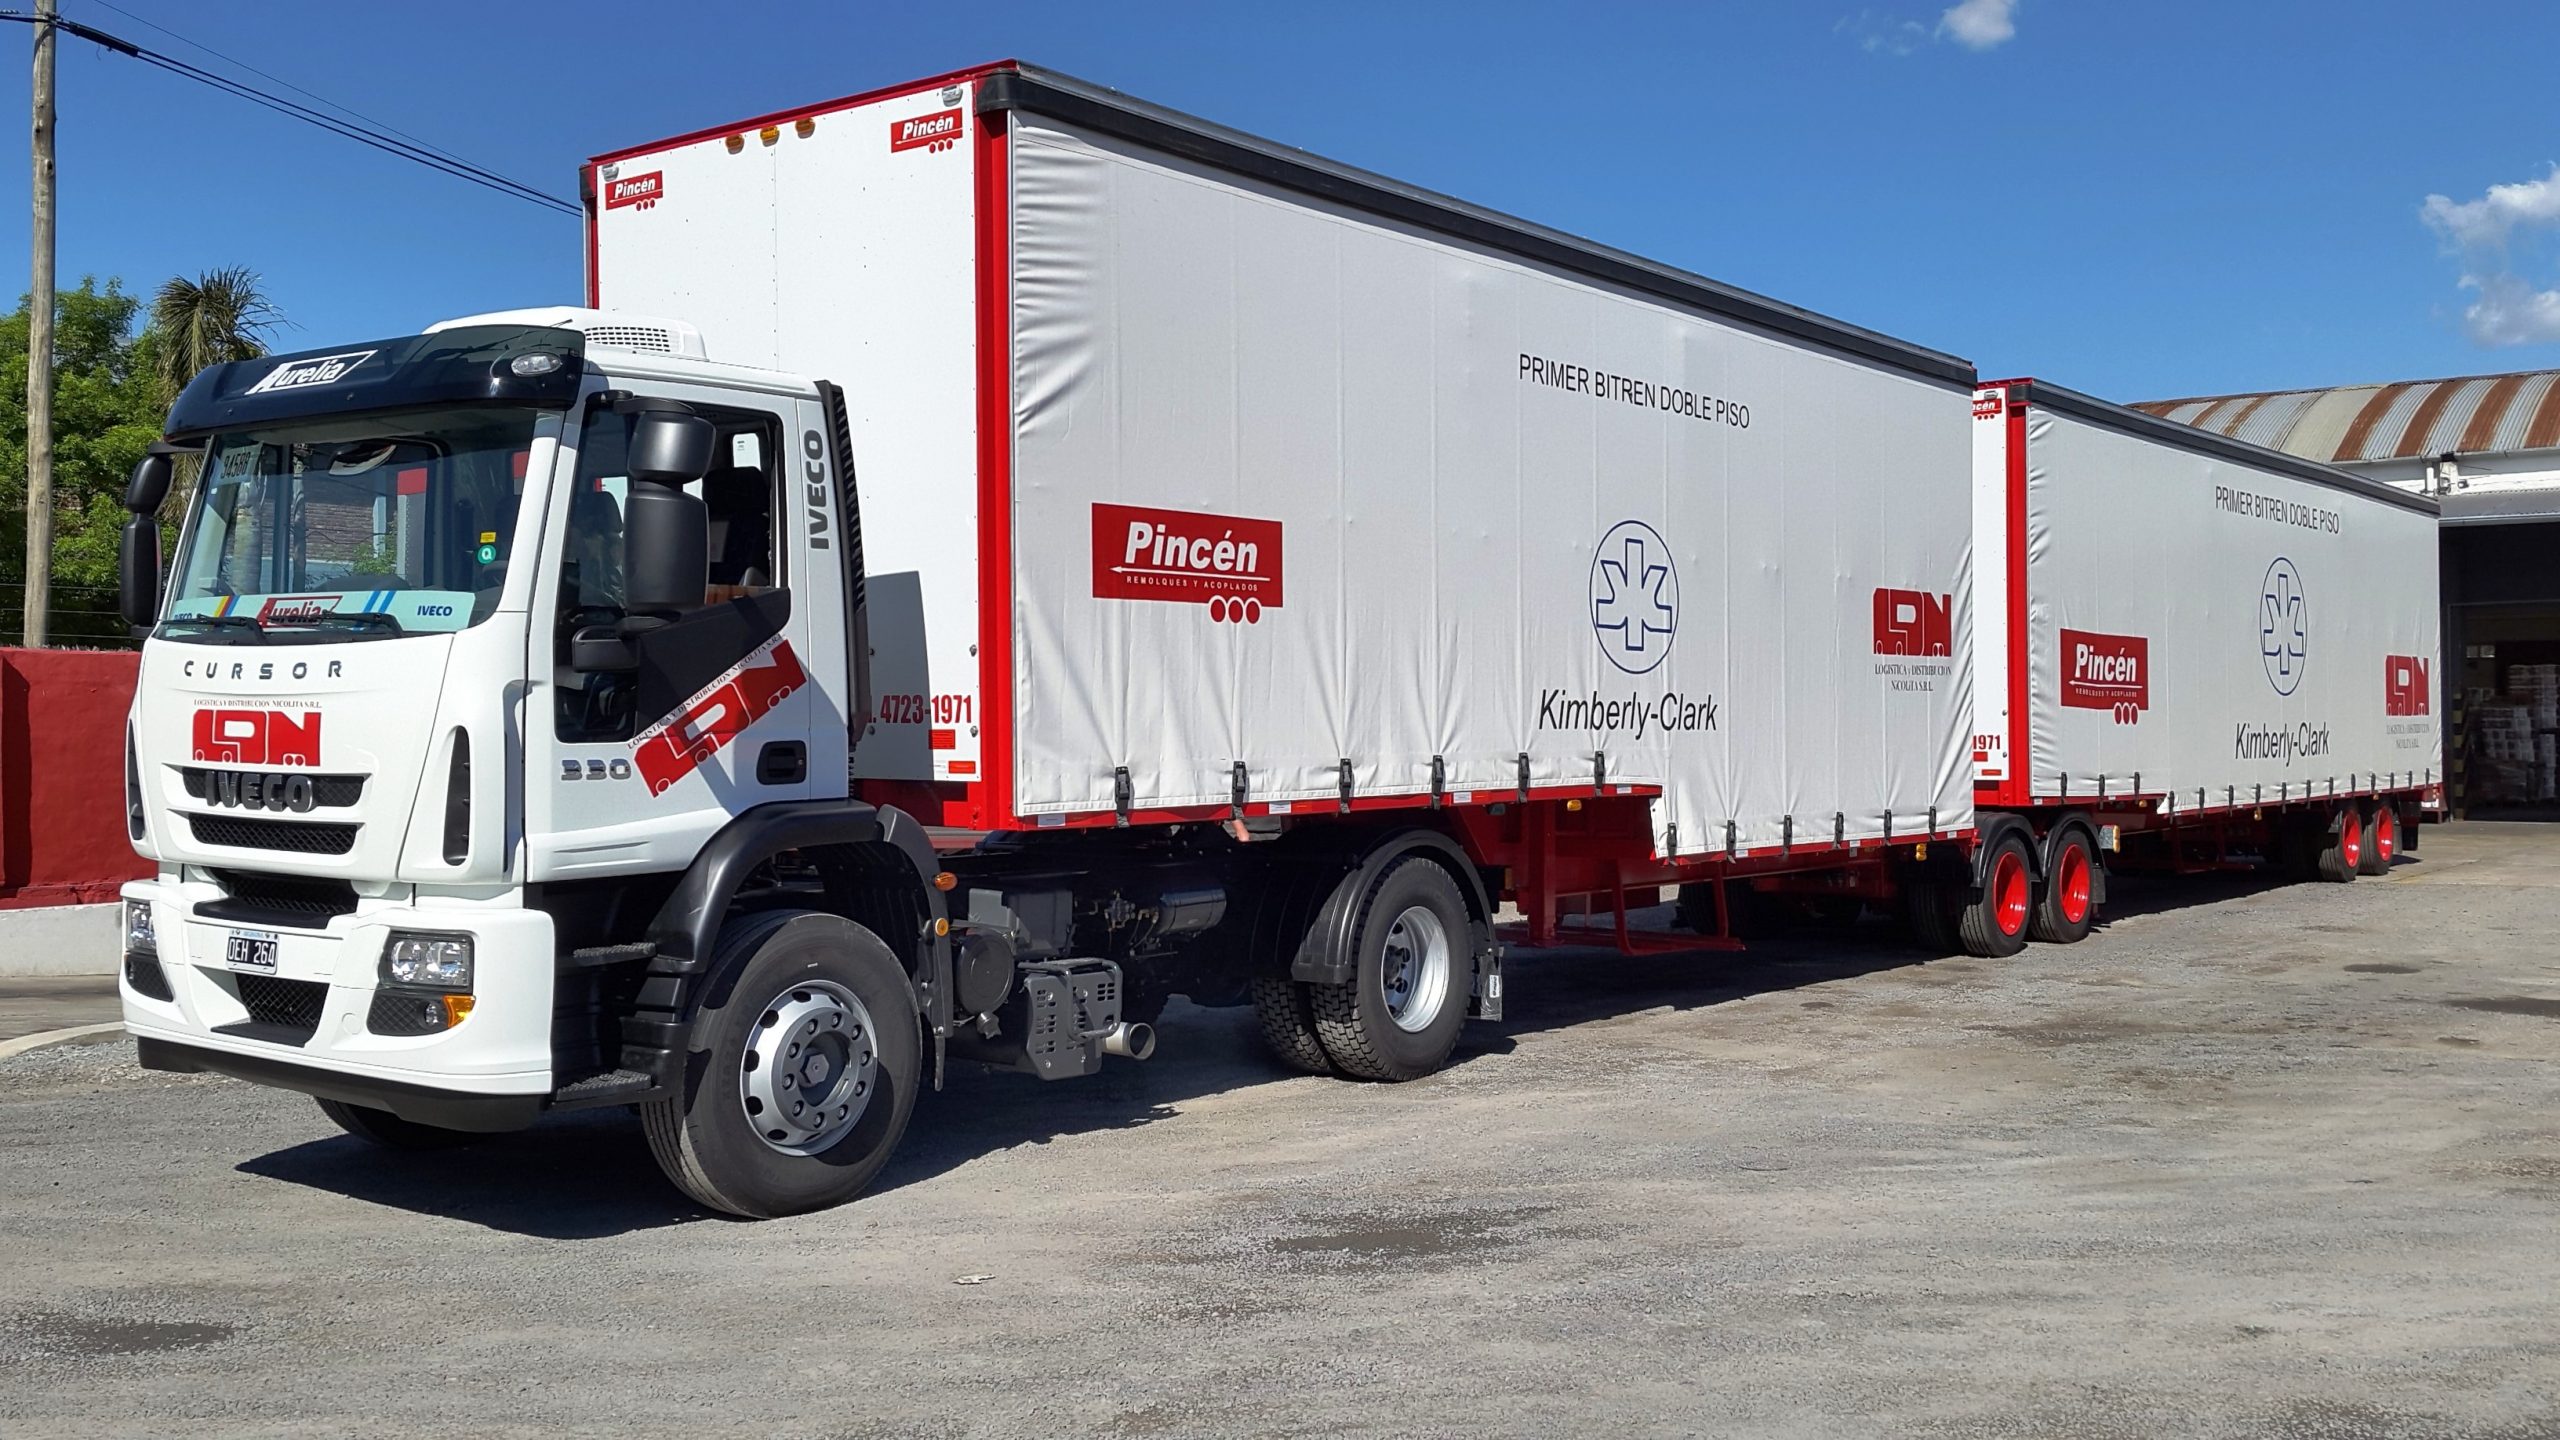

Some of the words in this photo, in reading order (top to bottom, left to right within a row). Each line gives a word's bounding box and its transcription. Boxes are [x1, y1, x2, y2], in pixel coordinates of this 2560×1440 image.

[902, 115, 954, 139] Pincén
[615, 177, 656, 199] Pincén
[245, 357, 345, 395] Aurelia
[1519, 353, 1589, 395] PRIMER
[1595, 371, 1656, 408] BITREN
[1660, 386, 1711, 420] DOBLE
[1716, 399, 1750, 429] PISO
[804, 429, 829, 550] IVECO
[2215, 486, 2253, 516] PRIMER
[2255, 495, 2288, 524] BITREN
[2290, 503, 2318, 530] DOBLE
[2320, 509, 2340, 534] PISO
[1125, 521, 1258, 573] Pincén
[1127, 575, 1188, 587] REMOLQUES
[1193, 580, 1198, 588] Y
[1203, 581, 1259, 592] ACOPLADOS
[416, 604, 453, 616] IVECO
[184, 660, 343, 680] CURSOR
[2074, 643, 2137, 683] Pincén
[880, 694, 972, 724] 4723-1971
[1539, 689, 1718, 740] Kimberly-Clark
[2235, 721, 2330, 768] Kimberly-Clark
[561, 758, 632, 781] 330
[205, 770, 314, 814] IVECO
[253, 942, 276, 966] 264
